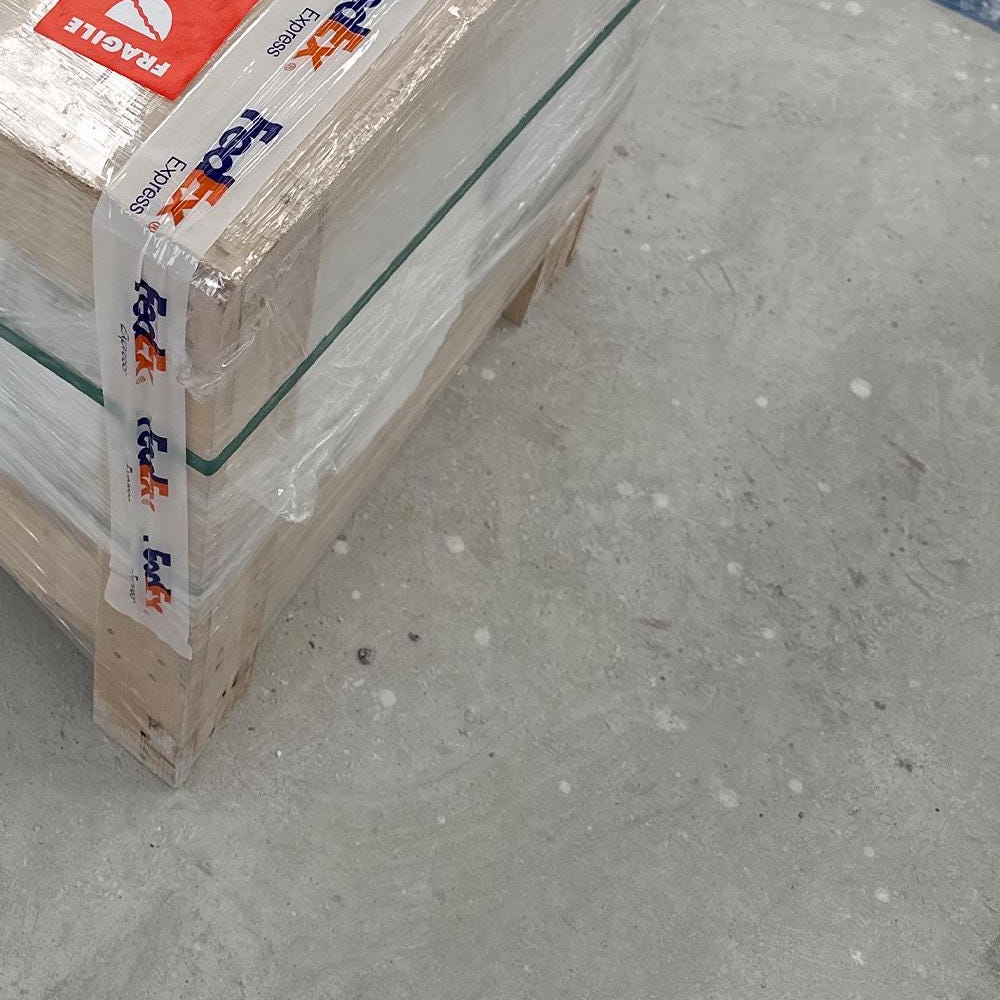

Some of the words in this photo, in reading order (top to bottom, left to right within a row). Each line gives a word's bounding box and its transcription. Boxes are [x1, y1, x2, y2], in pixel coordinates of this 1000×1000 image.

[63, 16, 172, 78] FRAGILE
[267, 8, 320, 57] Express
[130, 156, 187, 214] Express
[157, 109, 283, 226] FedEx
